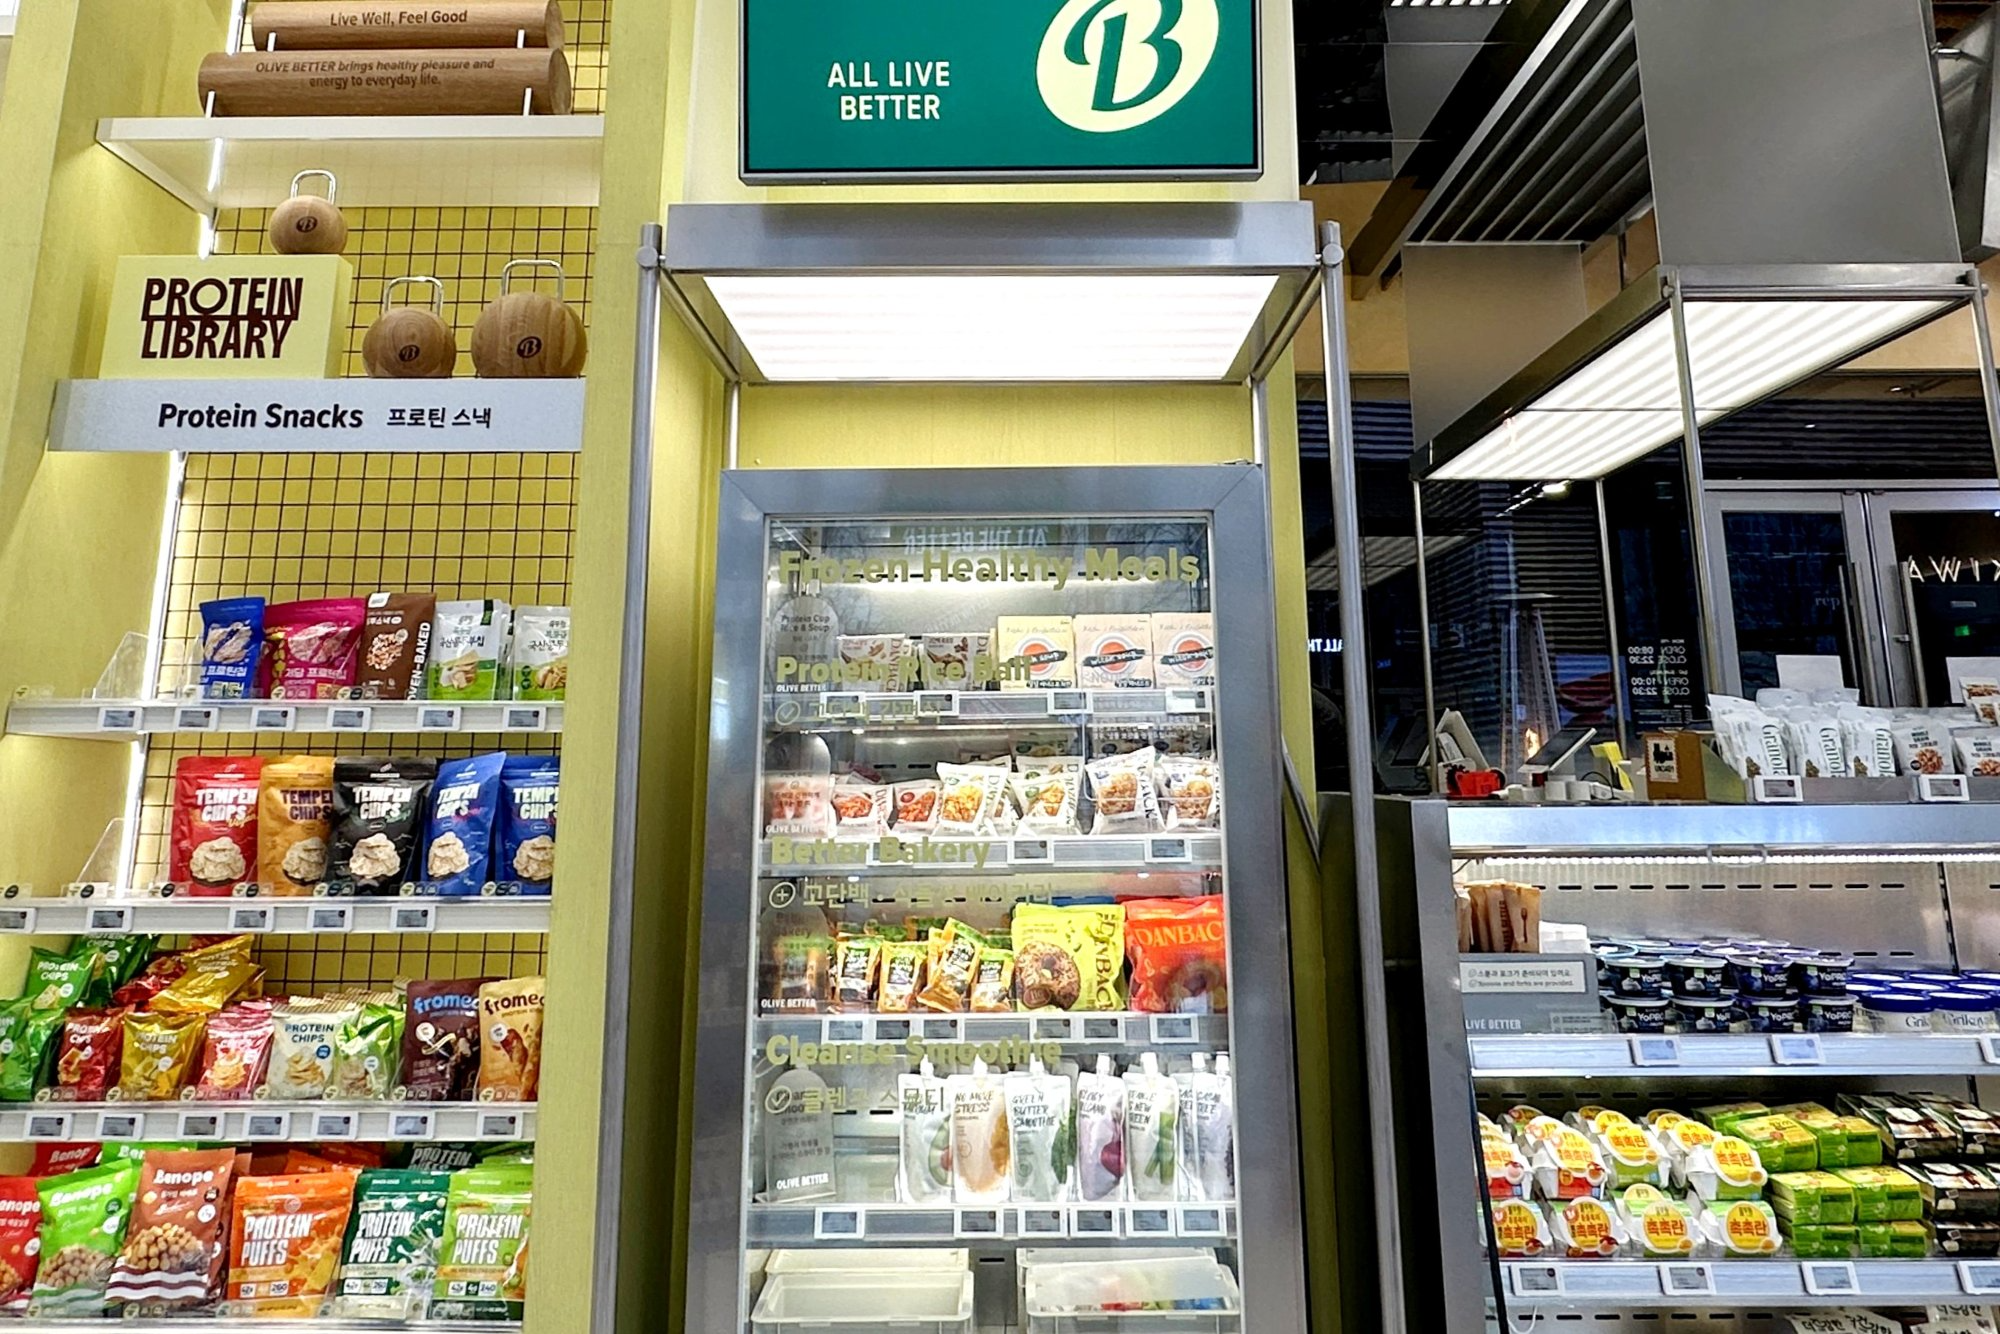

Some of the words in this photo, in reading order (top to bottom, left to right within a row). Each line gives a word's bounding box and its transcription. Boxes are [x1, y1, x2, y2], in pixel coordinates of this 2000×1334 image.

[330, 13, 358, 26] Live
[362, 11, 395, 26] Well,
[399, 12, 427, 25] Feel
[431, 10, 468, 23] Good
[256, 62, 289, 73] OLIVE
[293, 61, 336, 72] BETTER
[338, 60, 373, 74] brings
[376, 59, 418, 72] healthy
[420, 59, 470, 71] pleasure
[473, 59, 495, 69] and
[828, 62, 879, 87] ALL
[888, 61, 950, 87] LIVE
[310, 75, 348, 89] energy
[351, 75, 362, 86] to
[366, 73, 417, 87] everyday
[420, 73, 441, 85] life.
[840, 94, 940, 120] BETTER
[141, 278, 303, 320] PROTEIN
[141, 319, 293, 358] LIBRARY
[158, 403, 257, 428] Protein
[264, 403, 363, 427] Snacks
[386, 408, 446, 428] 프로틴
[452, 408, 492, 429] 스낵
[778, 551, 909, 584] Frozen
[922, 549, 1073, 591] Healthy
[1085, 548, 1200, 582] Meals
[408, 621, 432, 700] OVEN-BAKED
[776, 656, 886, 684] Protein
[899, 656, 964, 683] Rice
[776, 684, 798, 692] OLIVE
[195, 788, 259, 804] TEMPEH
[352, 787, 412, 803] TEMPEH
[437, 784, 481, 804] TEMPEH
[513, 787, 559, 803] TEMP
[202, 806, 247, 822] CHIPS
[290, 805, 331, 820] CHIPS
[360, 803, 401, 819] CHIPS
[436, 801, 469, 819] CHIPS
[771, 836, 869, 865] Better
[879, 836, 990, 870] Bakery
[1135, 922, 1224, 946] DANBAC
[761, 999, 785, 1009] OLIVE
[787, 999, 816, 1009] BETTER
[284, 1023, 334, 1033] PROTEIN
[1465, 1018, 1487, 1030] LIVE
[1488, 1019, 1522, 1030] BETTER
[291, 1033, 325, 1044] CHIPS
[766, 1034, 896, 1066] Cleanse
[905, 1034, 1062, 1066] Smoothie
[955, 1102, 990, 1114] STRESS
[49, 1147, 91, 1164] Benop
[410, 1148, 472, 1166] PROTEIN
[776, 1177, 800, 1190] OLIVE
[802, 1173, 829, 1187] BETTER
[243, 1213, 314, 1240] PROTEIN
[358, 1211, 415, 1238] PROTEIN
[456, 1213, 523, 1239] PROTEIN
[1647, 1220, 1685, 1236] 촉촉란
[1729, 1220, 1768, 1236] 촉촉란
[241, 1239, 289, 1266] PUFFS
[350, 1237, 391, 1263] PUFFS
[452, 1239, 500, 1265] PUFFS
